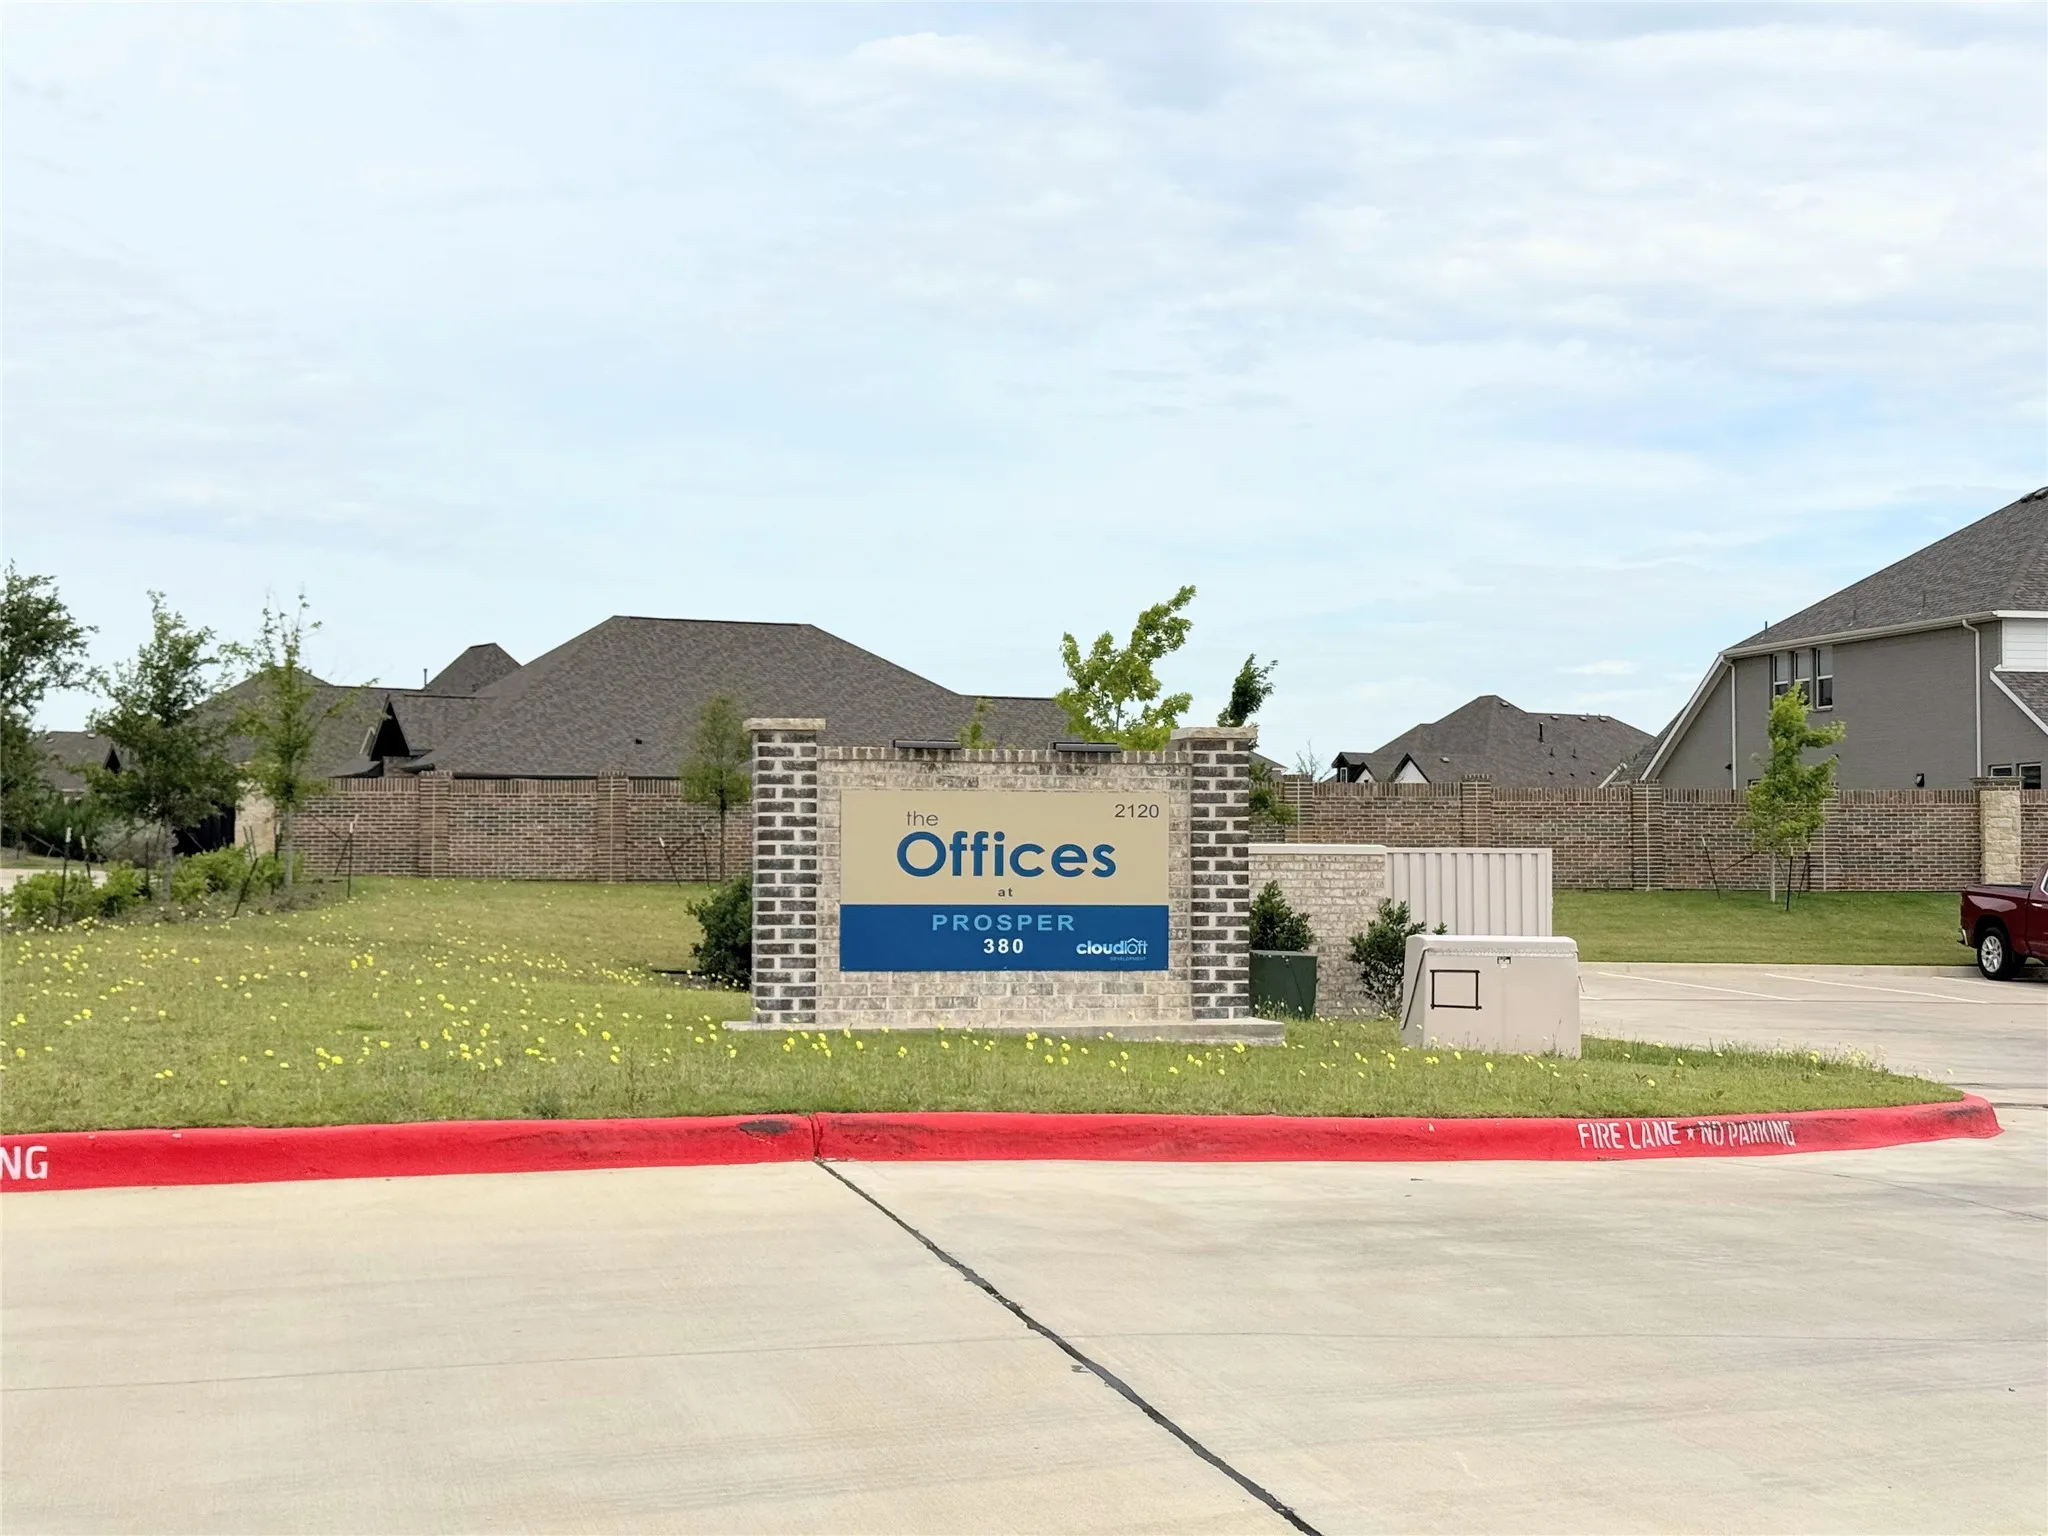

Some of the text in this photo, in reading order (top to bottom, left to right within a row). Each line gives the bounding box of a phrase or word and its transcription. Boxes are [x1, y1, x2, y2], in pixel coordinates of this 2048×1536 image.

[906, 810, 939, 827] the
[1114, 803, 1160, 819] 2120
[896, 830, 1117, 878] Offices
[997, 887, 1013, 897] at
[932, 914, 1075, 931] PROSPER
[983, 938, 1024, 954] 380
[1577, 1119, 1796, 1150] FIRE LANE NO PARKING
